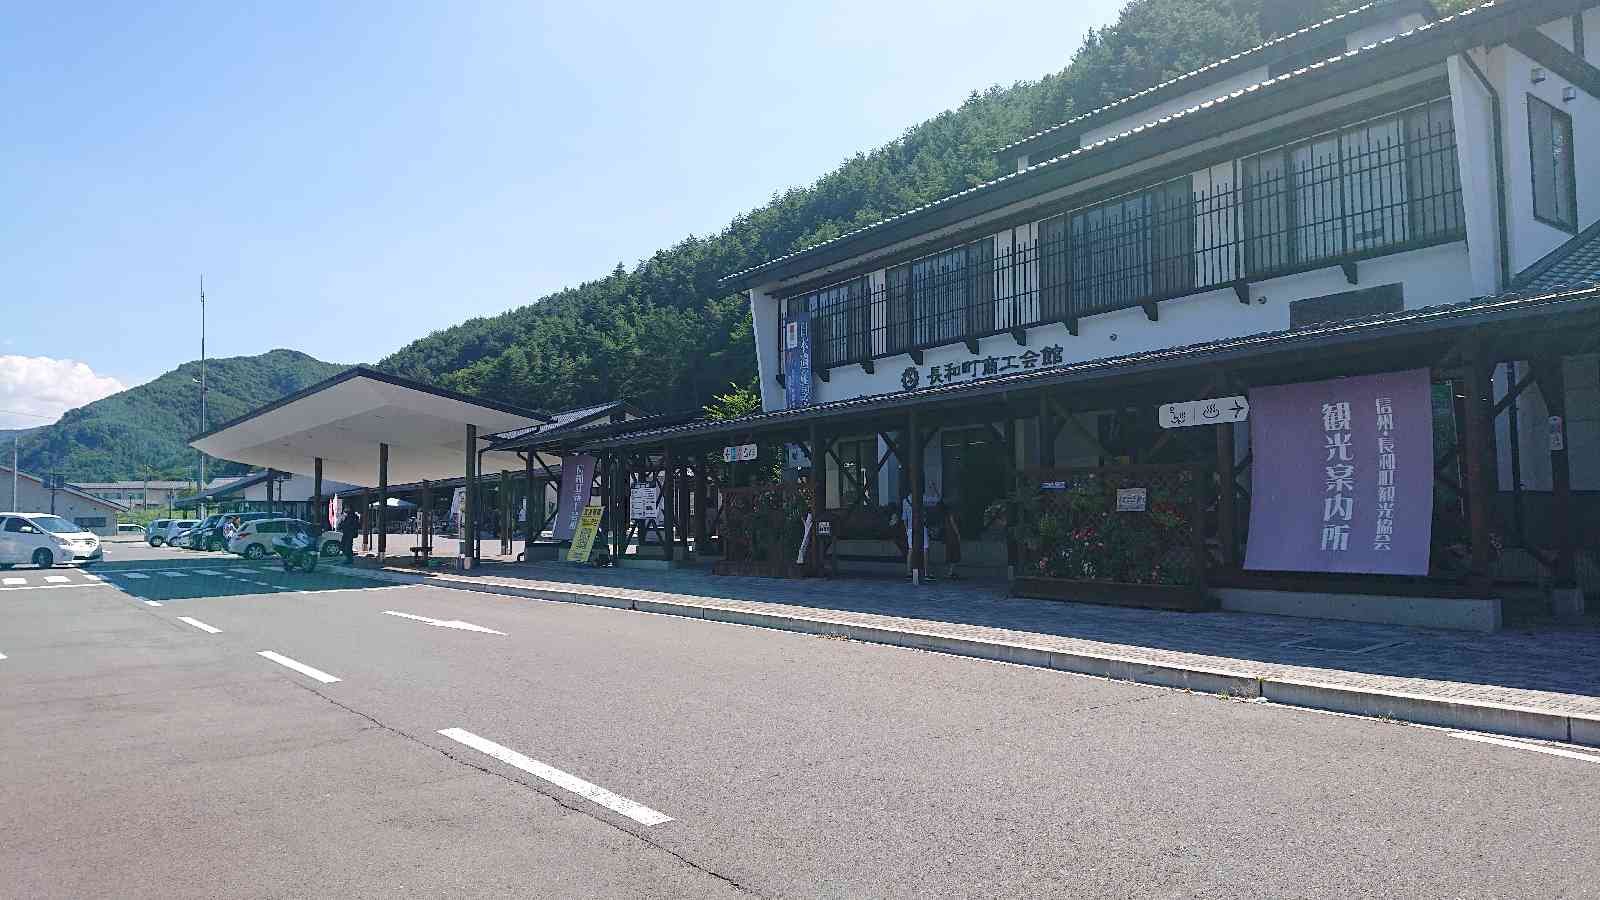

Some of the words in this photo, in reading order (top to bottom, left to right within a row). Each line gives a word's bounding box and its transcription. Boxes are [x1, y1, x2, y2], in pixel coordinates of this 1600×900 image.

[928, 345, 1064, 385] 長和町商工会館
[1321, 402, 1354, 551] 観光案内所
